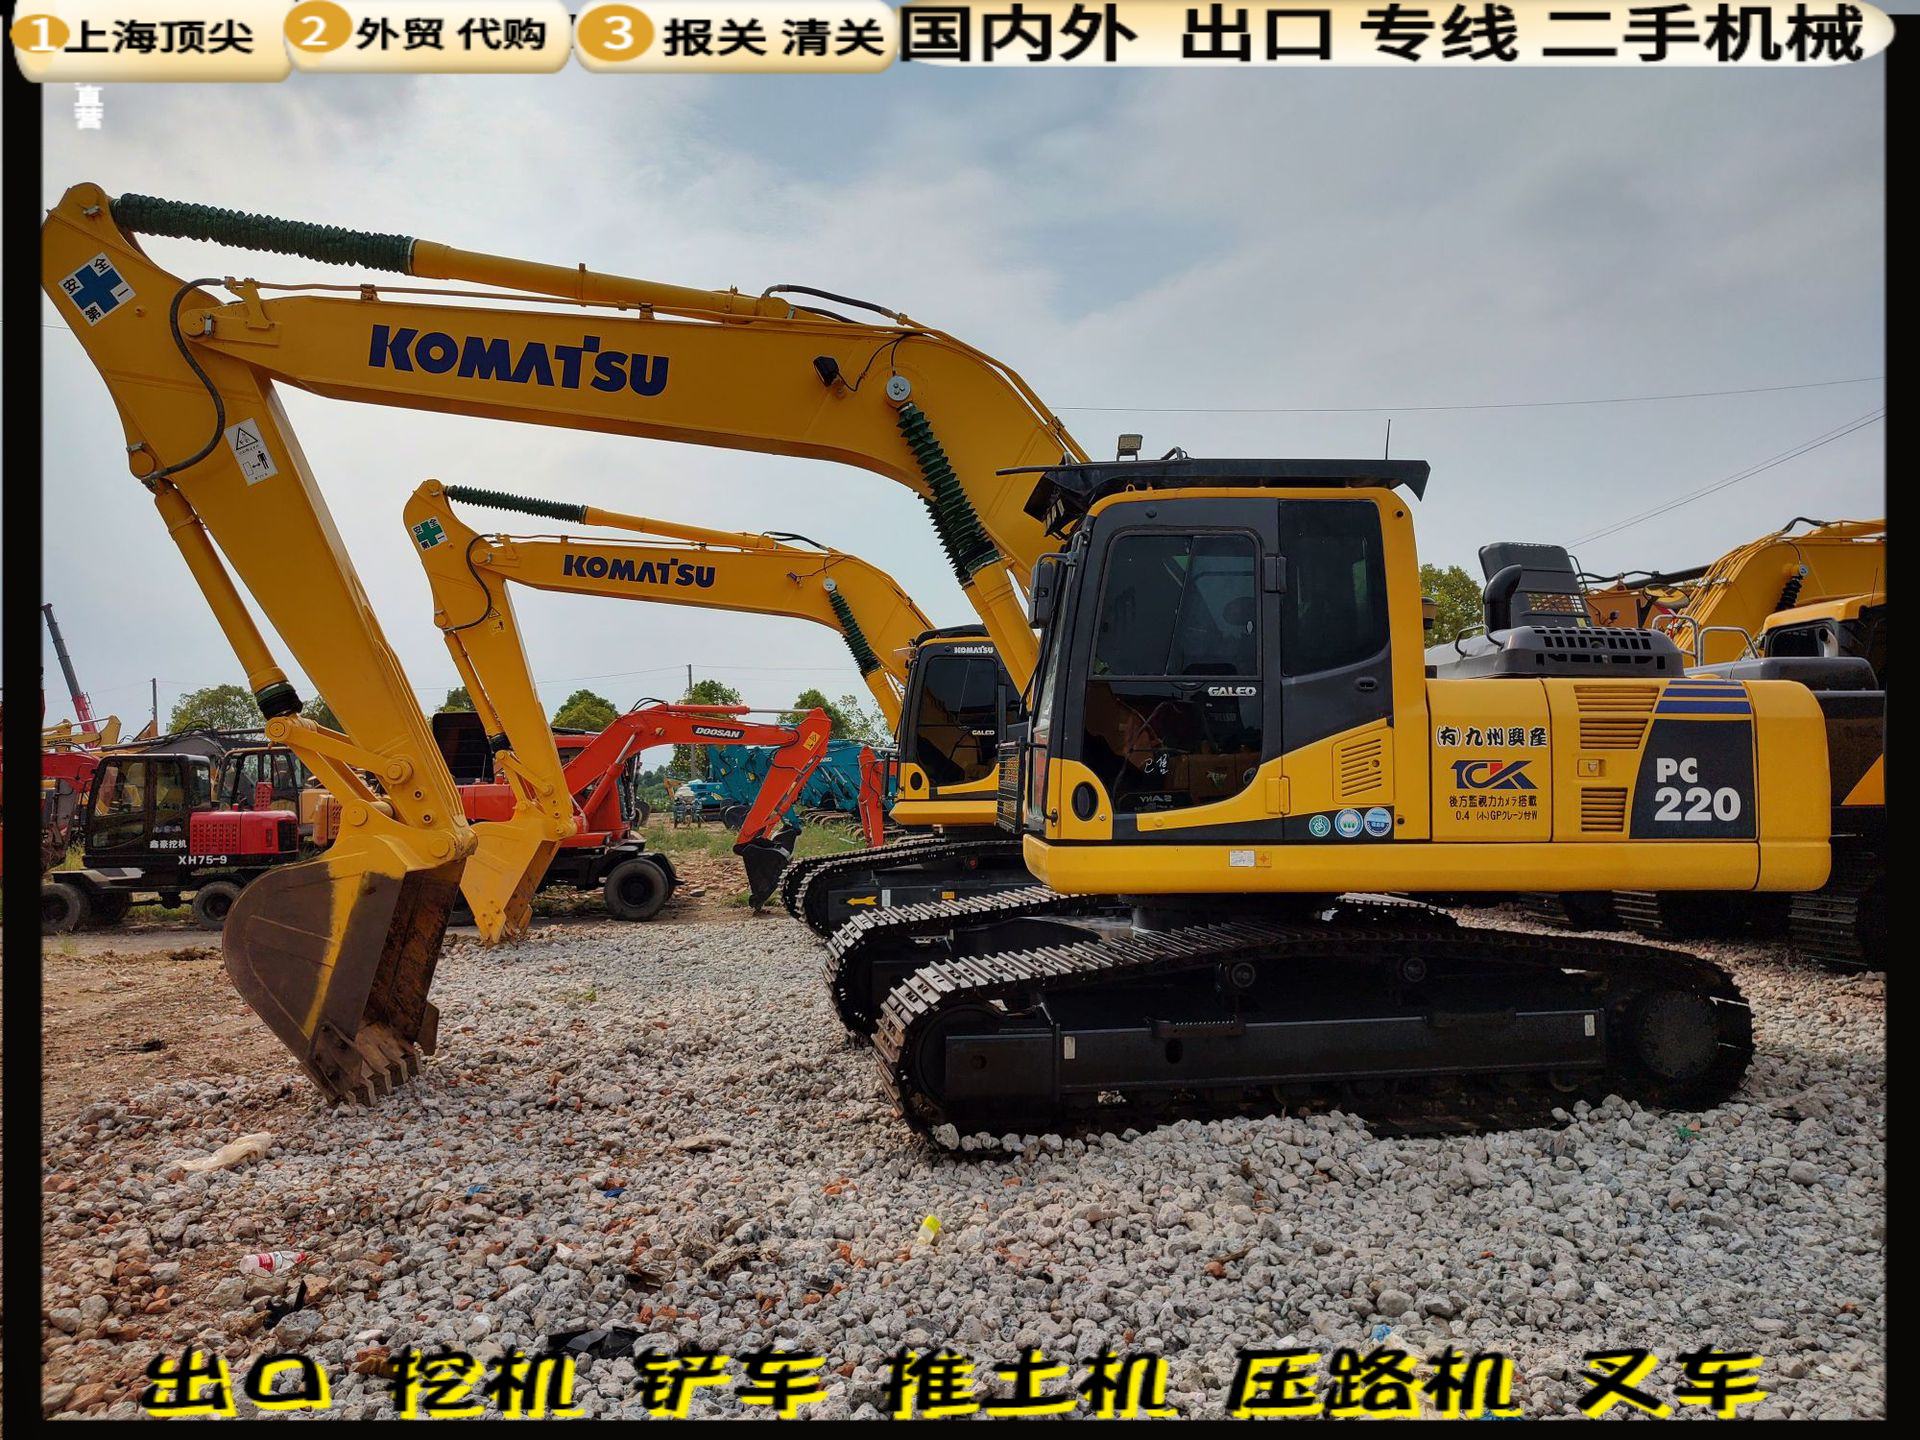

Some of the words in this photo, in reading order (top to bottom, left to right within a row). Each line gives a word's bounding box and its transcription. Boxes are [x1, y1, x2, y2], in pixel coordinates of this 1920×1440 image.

[368, 324, 670, 397] KOMATSU
[563, 554, 716, 589] KOMATSU
[953, 645, 994, 654] KOMATSU
[1207, 686, 1257, 697] GALEO
[695, 727, 741, 738] DOOSAN
[1656, 758, 1698, 783] PC
[1654, 787, 1742, 822] 220
[1455, 811, 1470, 821] 0.4
[178, 855, 228, 865] XH75-9
